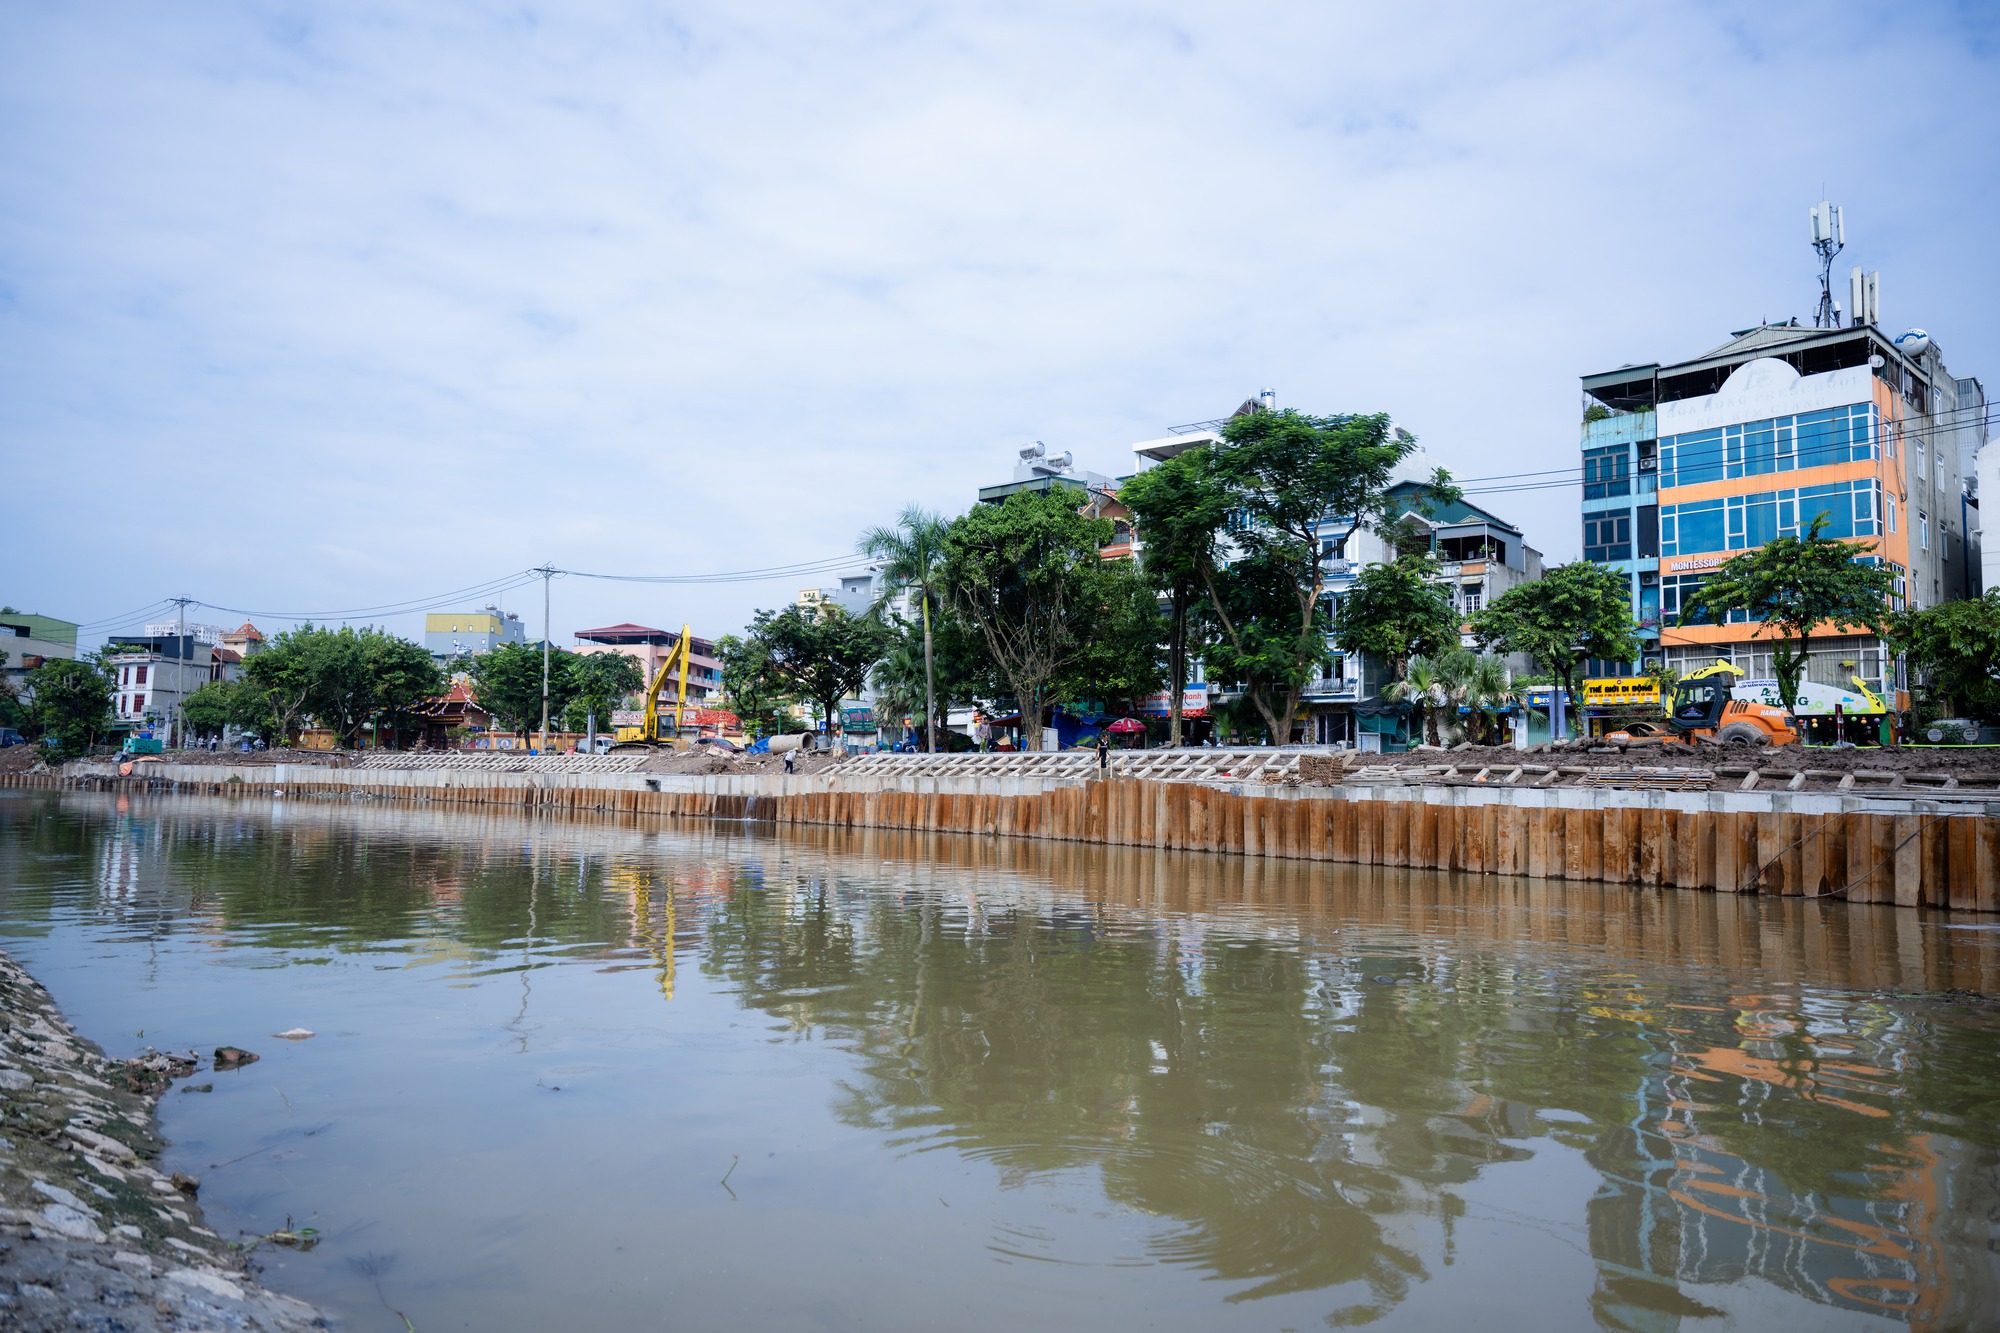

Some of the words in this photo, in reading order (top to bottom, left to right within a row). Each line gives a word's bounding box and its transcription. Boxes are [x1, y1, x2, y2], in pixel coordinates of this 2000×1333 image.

[1671, 558, 1722, 571] MONTESSORI
[1589, 685, 1602, 693] THẾ
[1604, 685, 1619, 693] GIỚI
[1632, 684, 1653, 692] ĐỘNG
[1760, 709, 1782, 717] HAMM
